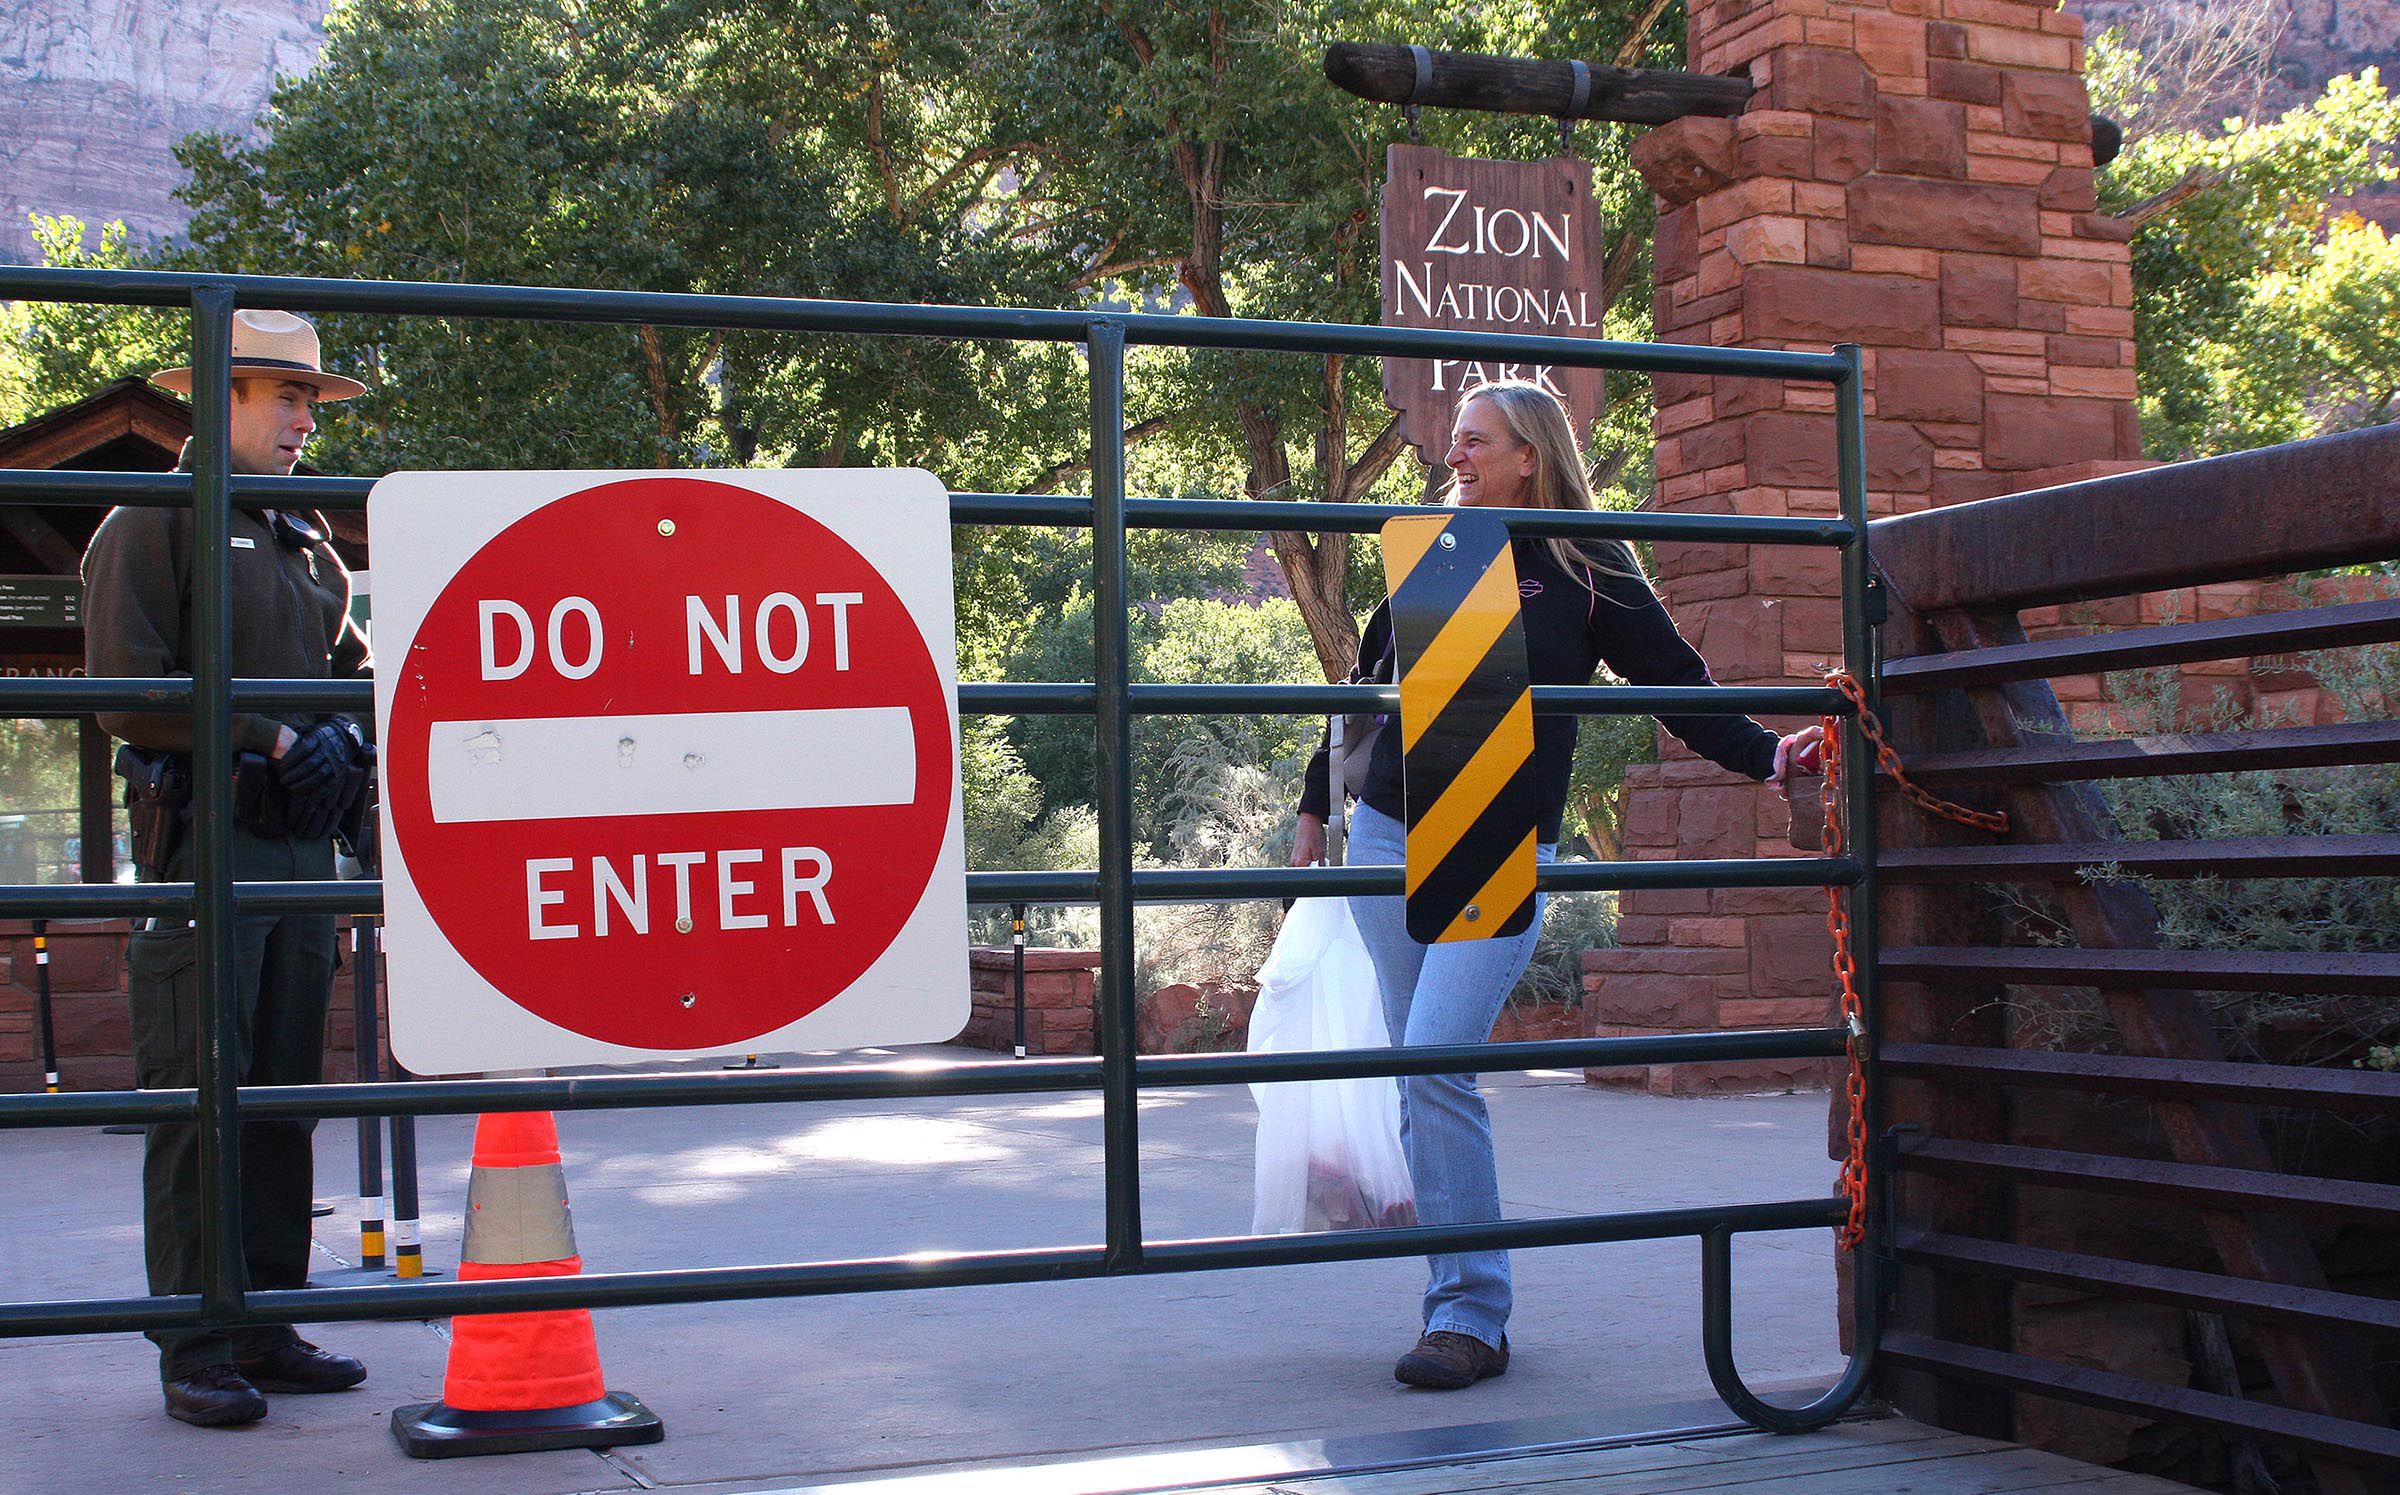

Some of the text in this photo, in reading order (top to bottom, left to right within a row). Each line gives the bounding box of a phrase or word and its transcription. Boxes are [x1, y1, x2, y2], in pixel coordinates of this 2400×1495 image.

[478, 591, 864, 681] DO NOT
[525, 846, 836, 941] ENTER
